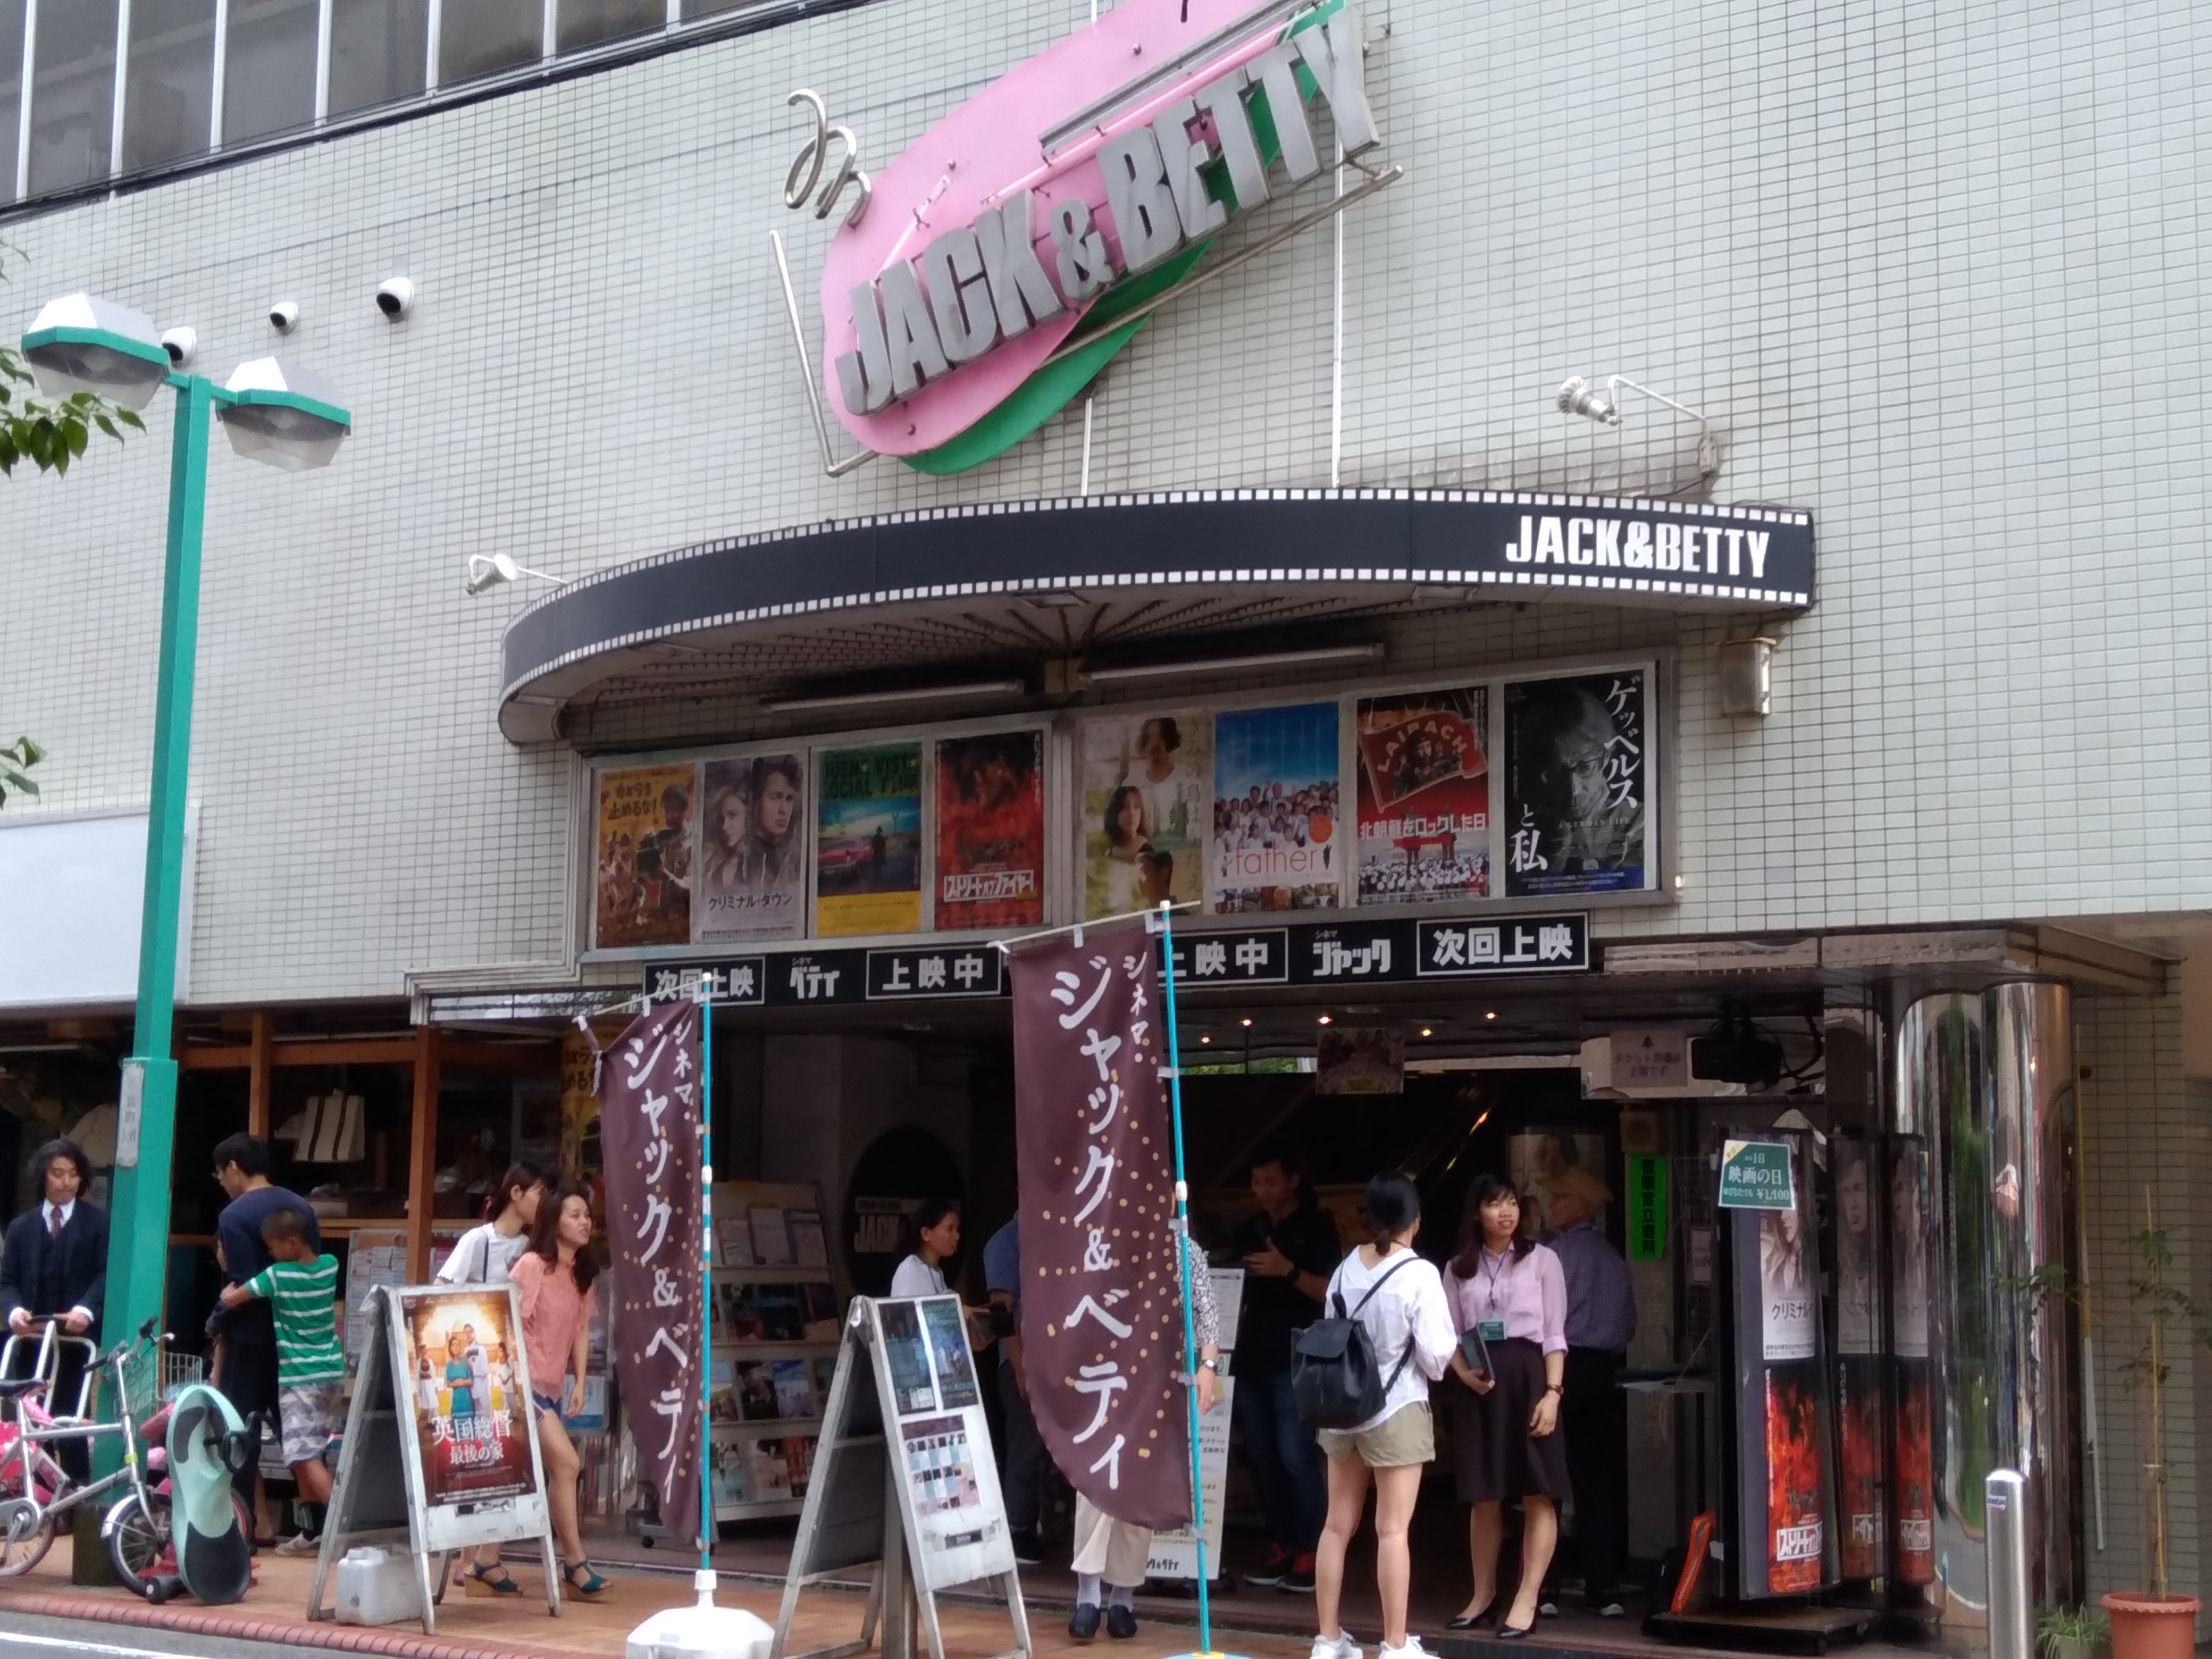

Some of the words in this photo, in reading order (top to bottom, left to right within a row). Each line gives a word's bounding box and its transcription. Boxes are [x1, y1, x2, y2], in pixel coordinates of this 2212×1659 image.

[835, 187, 1063, 416] JACK
[1055, 198, 1115, 301] &
[1095, 10, 1381, 275] BETTY
[1505, 515, 1770, 578] JACK&BETTY
[1604, 675, 1641, 810] ゲッベルス
[1236, 842, 1317, 875] father
[1509, 803, 1548, 873] と私
[883, 953, 983, 991] 上映中
[1312, 939, 1390, 976] ジャック
[1434, 924, 1572, 966] 次回上映
[1728, 1165, 1782, 1185] 映画の日
[1050, 955, 1133, 1489] ジャック&ベティ
[624, 1023, 688, 1504] ジャック&ベティ
